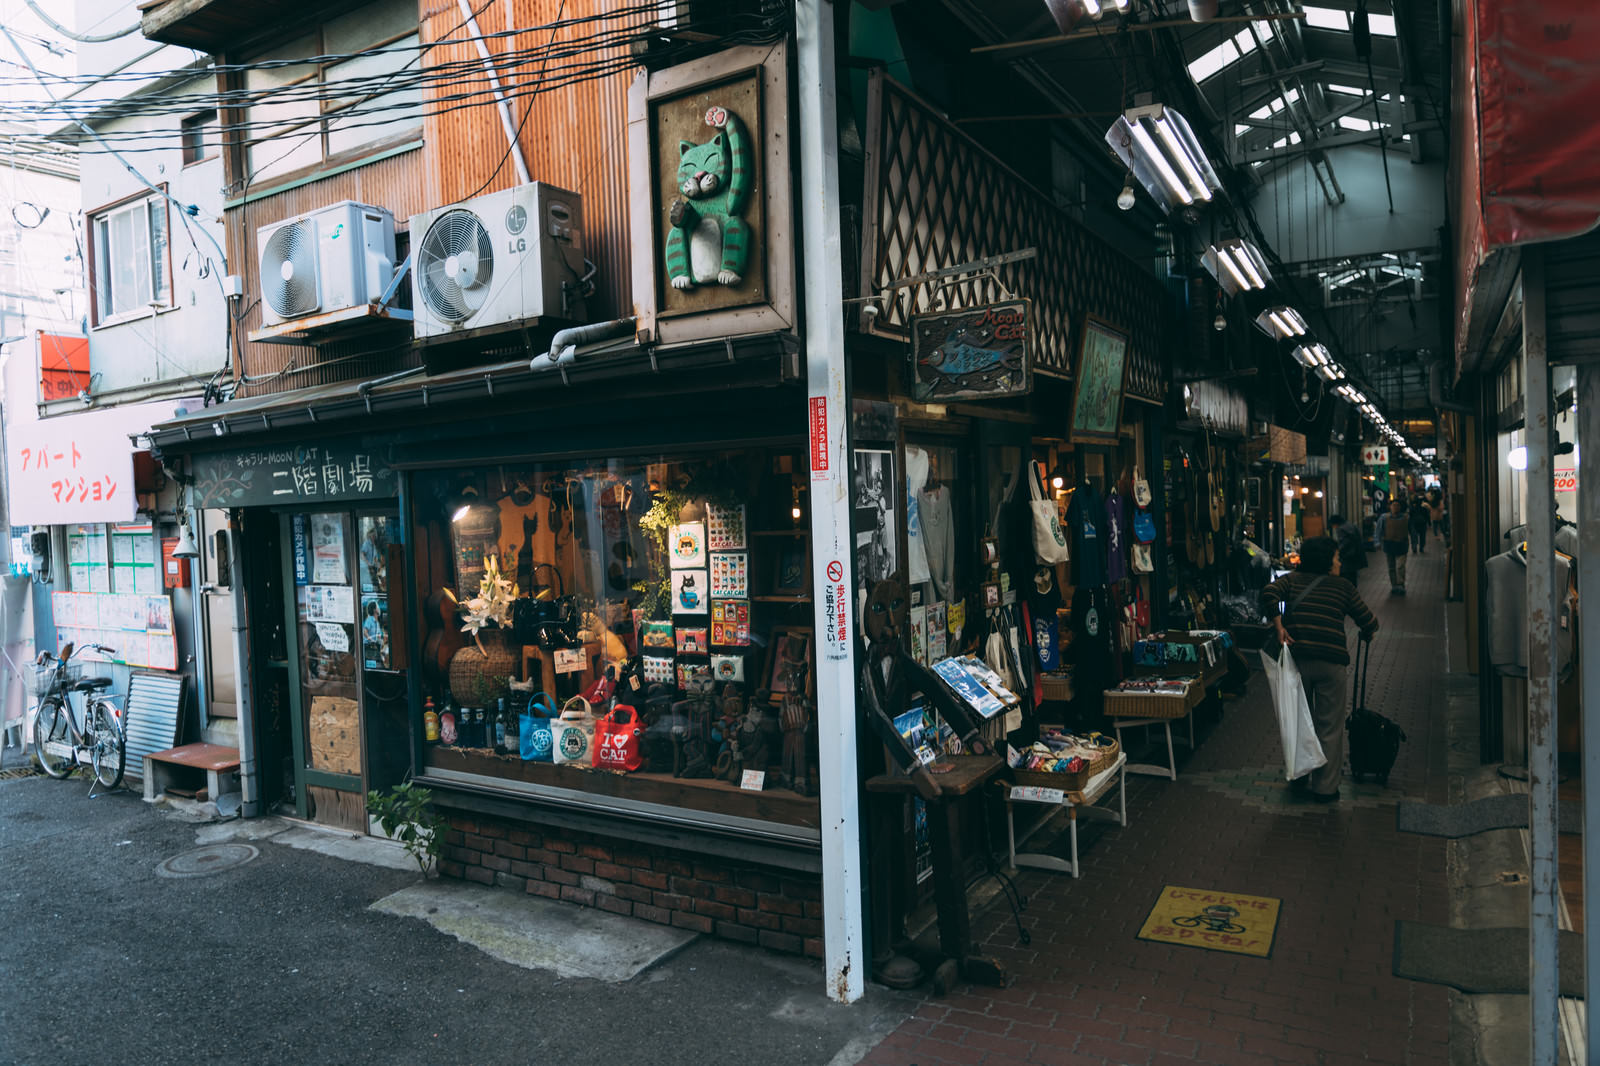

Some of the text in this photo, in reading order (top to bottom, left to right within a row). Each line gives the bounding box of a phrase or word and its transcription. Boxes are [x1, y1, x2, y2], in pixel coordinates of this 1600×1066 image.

[508, 238, 526, 254] LG
[975, 306, 1023, 326] Moon
[994, 324, 1027, 340] Cat
[818, 398, 827, 469] 防犯カメラ監視中
[21, 440, 82, 471] アパート
[272, 450, 374, 497] 二階劇場
[51, 474, 118, 503] マンション
[825, 585, 836, 647] ご協力下さい。
[836, 584, 847, 651] 歩行禁煙に
[601, 732, 614, 748] I
[600, 748, 628, 761] CAT
[1170, 890, 1270, 910] じてんしゃは
